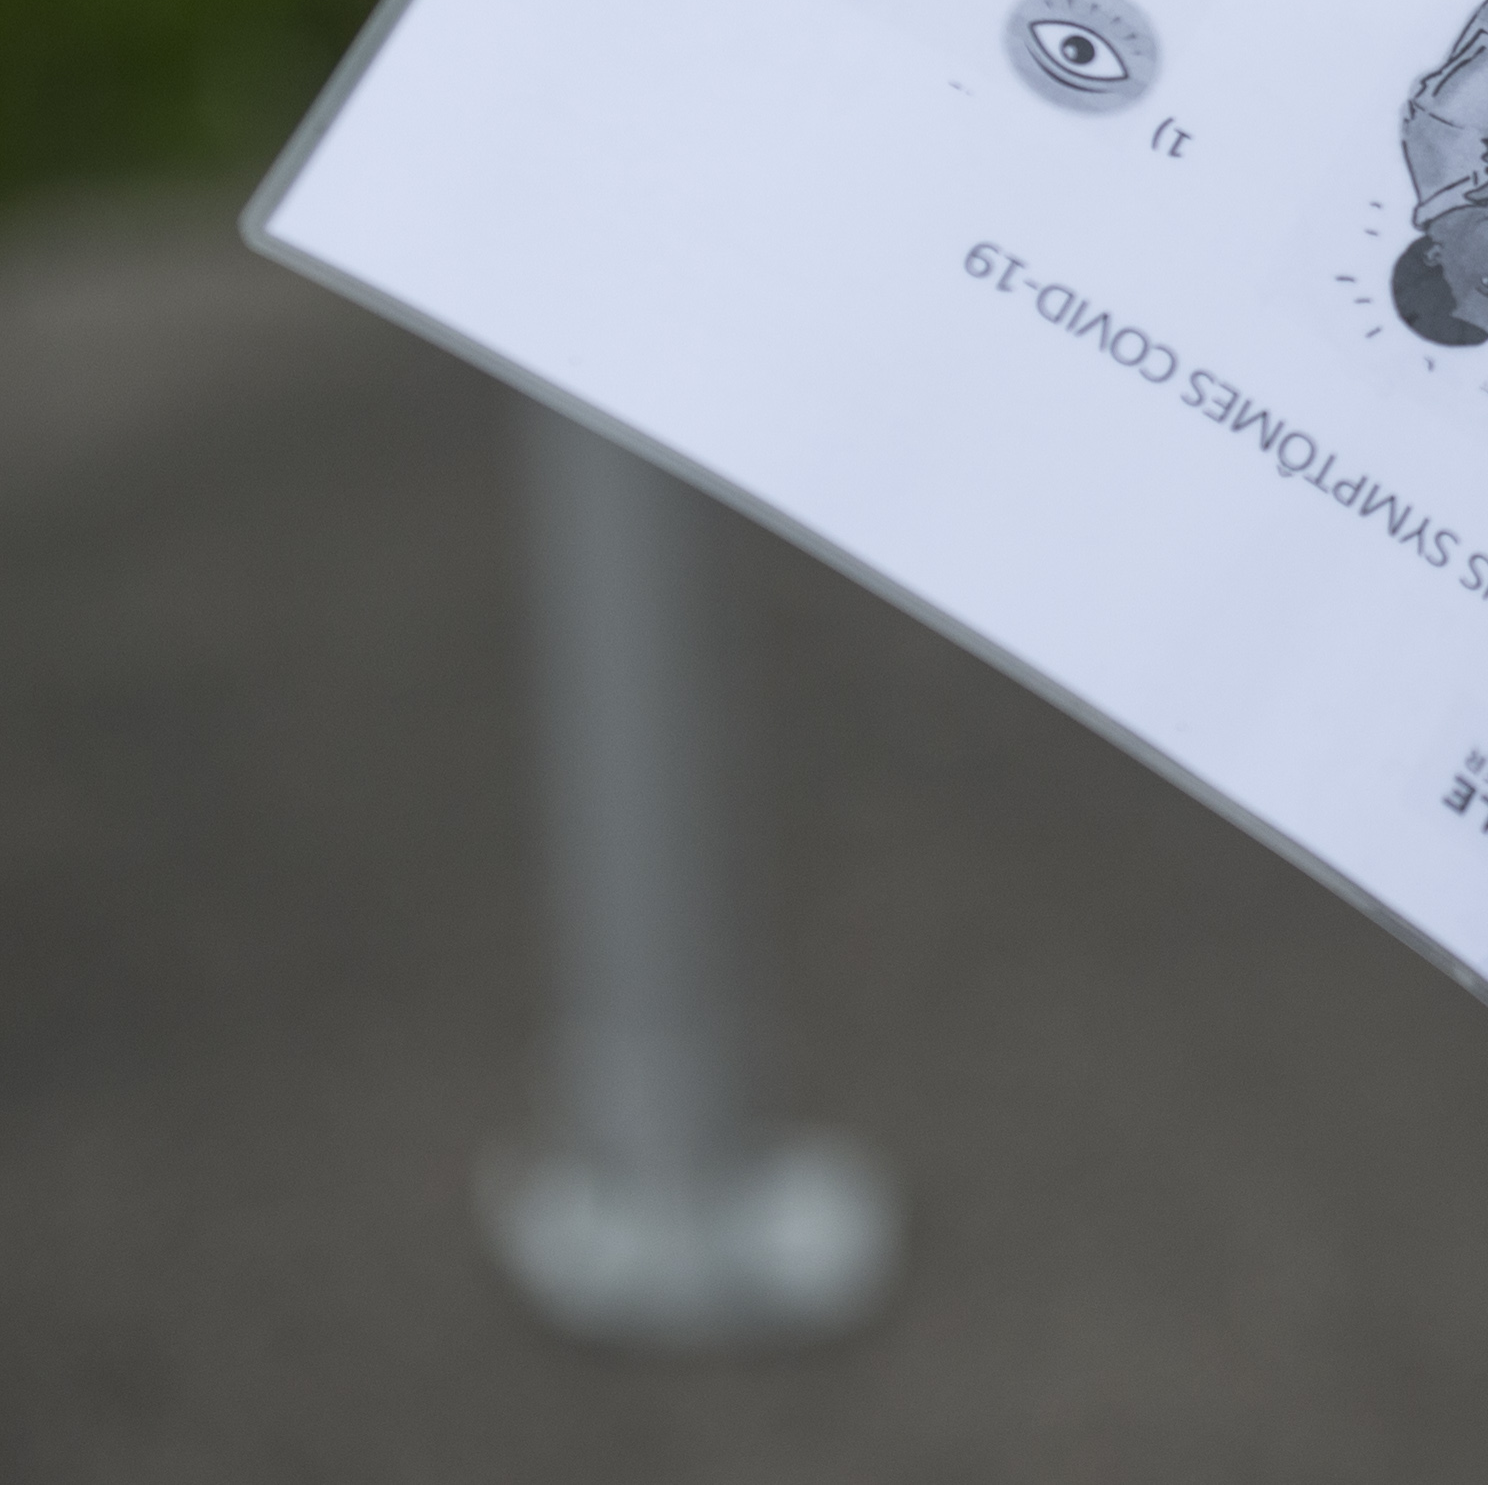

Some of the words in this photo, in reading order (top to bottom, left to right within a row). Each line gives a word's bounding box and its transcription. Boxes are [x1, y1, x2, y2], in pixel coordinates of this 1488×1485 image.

[1151, 116, 1192, 158] 1)
[962, 238, 1180, 386] COVID-19
[1180, 368, 1462, 570] SYMPTÔMES
